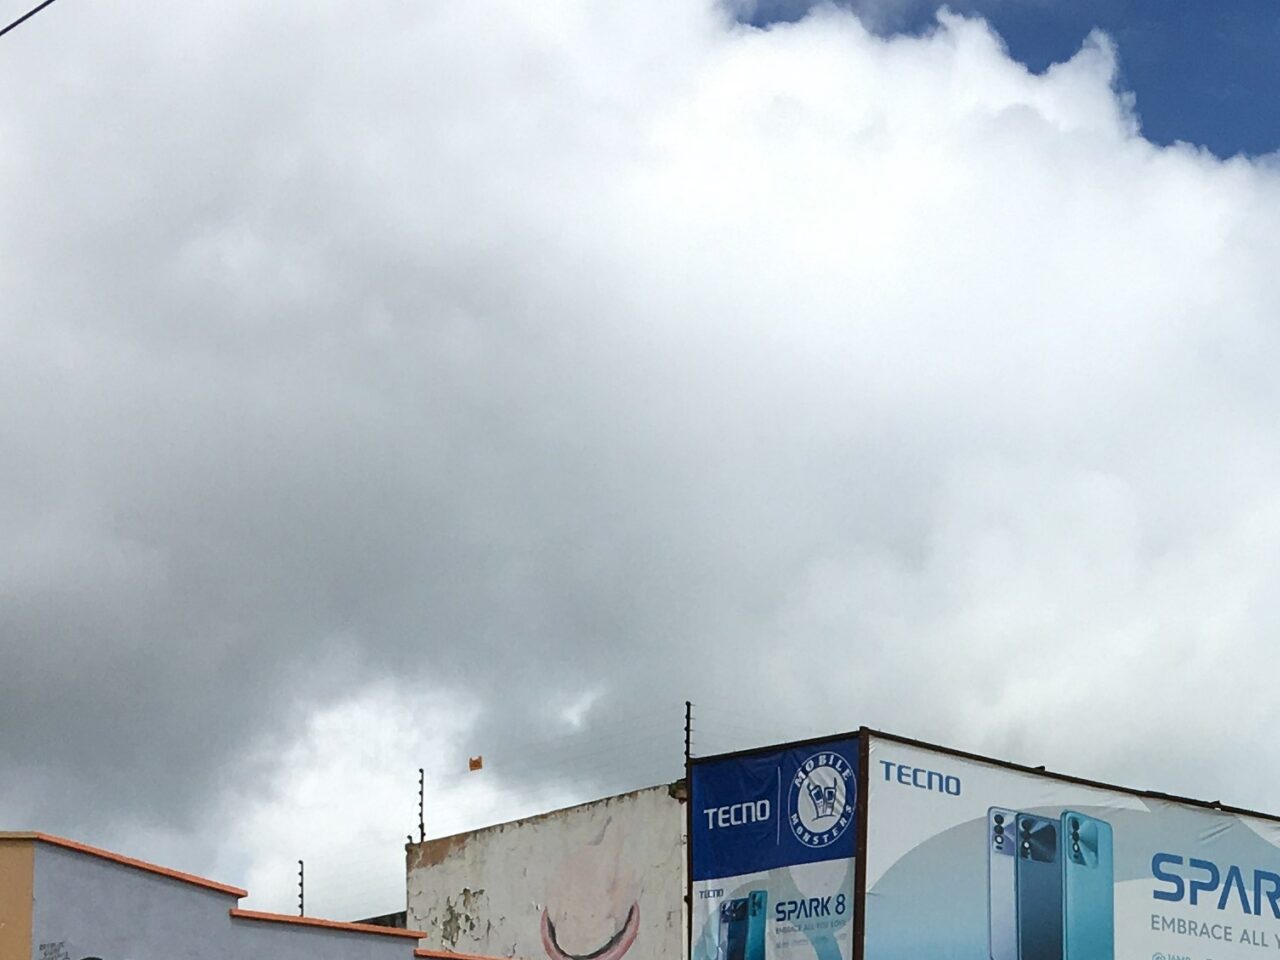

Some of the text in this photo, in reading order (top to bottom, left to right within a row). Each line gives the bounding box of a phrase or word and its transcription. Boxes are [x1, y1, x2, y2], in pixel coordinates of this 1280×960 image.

[794, 753, 852, 787] MOBILE
[879, 759, 961, 796] TECNO
[703, 799, 771, 830] TECNO
[775, 894, 846, 922] SPARK 8
[1151, 914, 1233, 942] EMBRACE
[1239, 928, 1269, 948] ALL
